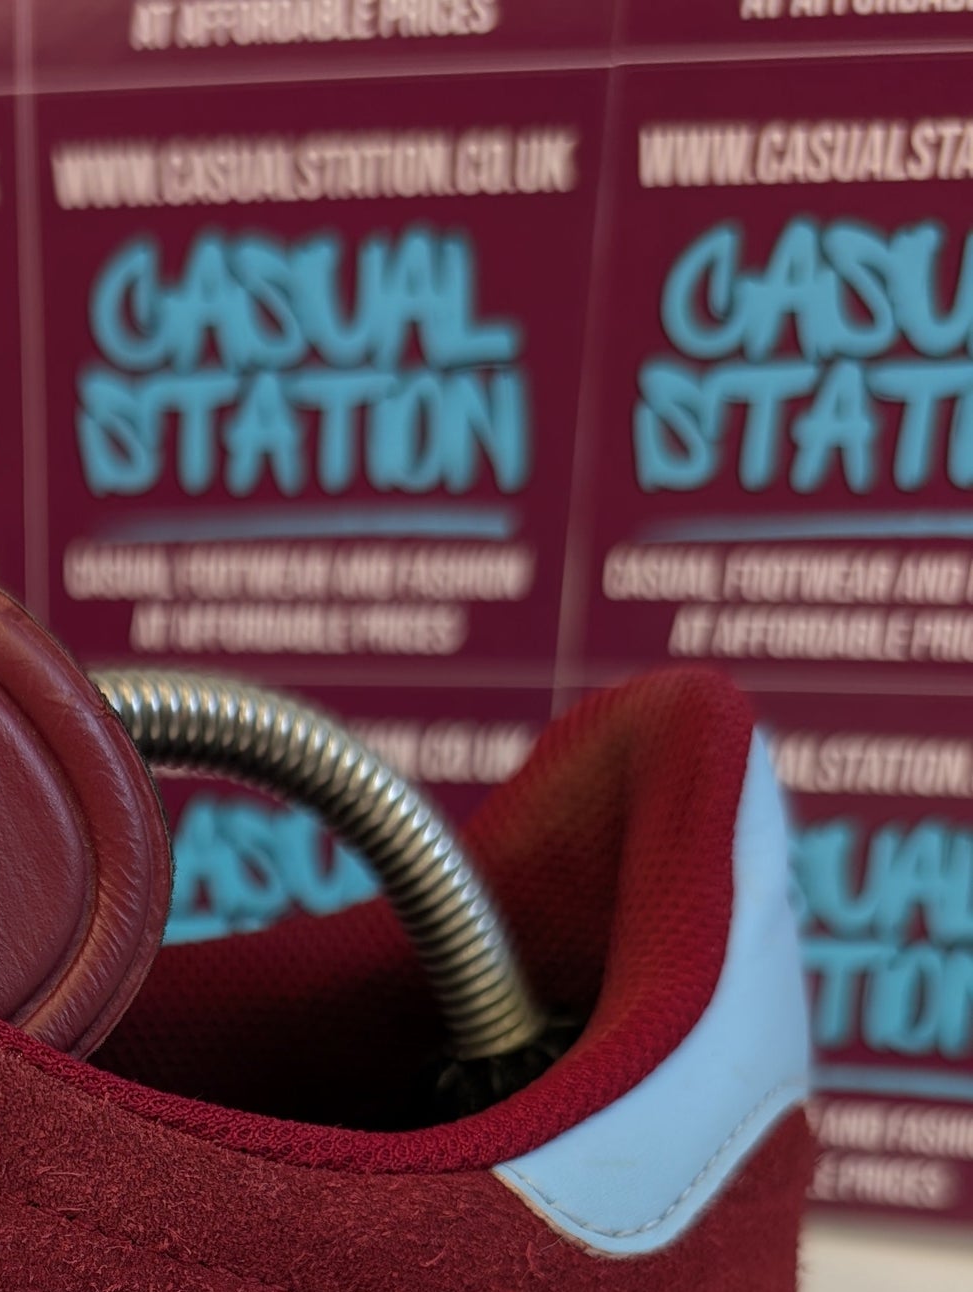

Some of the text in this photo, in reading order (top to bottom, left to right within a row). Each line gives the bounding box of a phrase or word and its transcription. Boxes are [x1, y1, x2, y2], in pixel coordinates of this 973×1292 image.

[51, 128, 579, 210] WWW.CASUALSTATION.CO.UK
[88, 220, 521, 375] CASUAL
[74, 362, 530, 498] STATION
